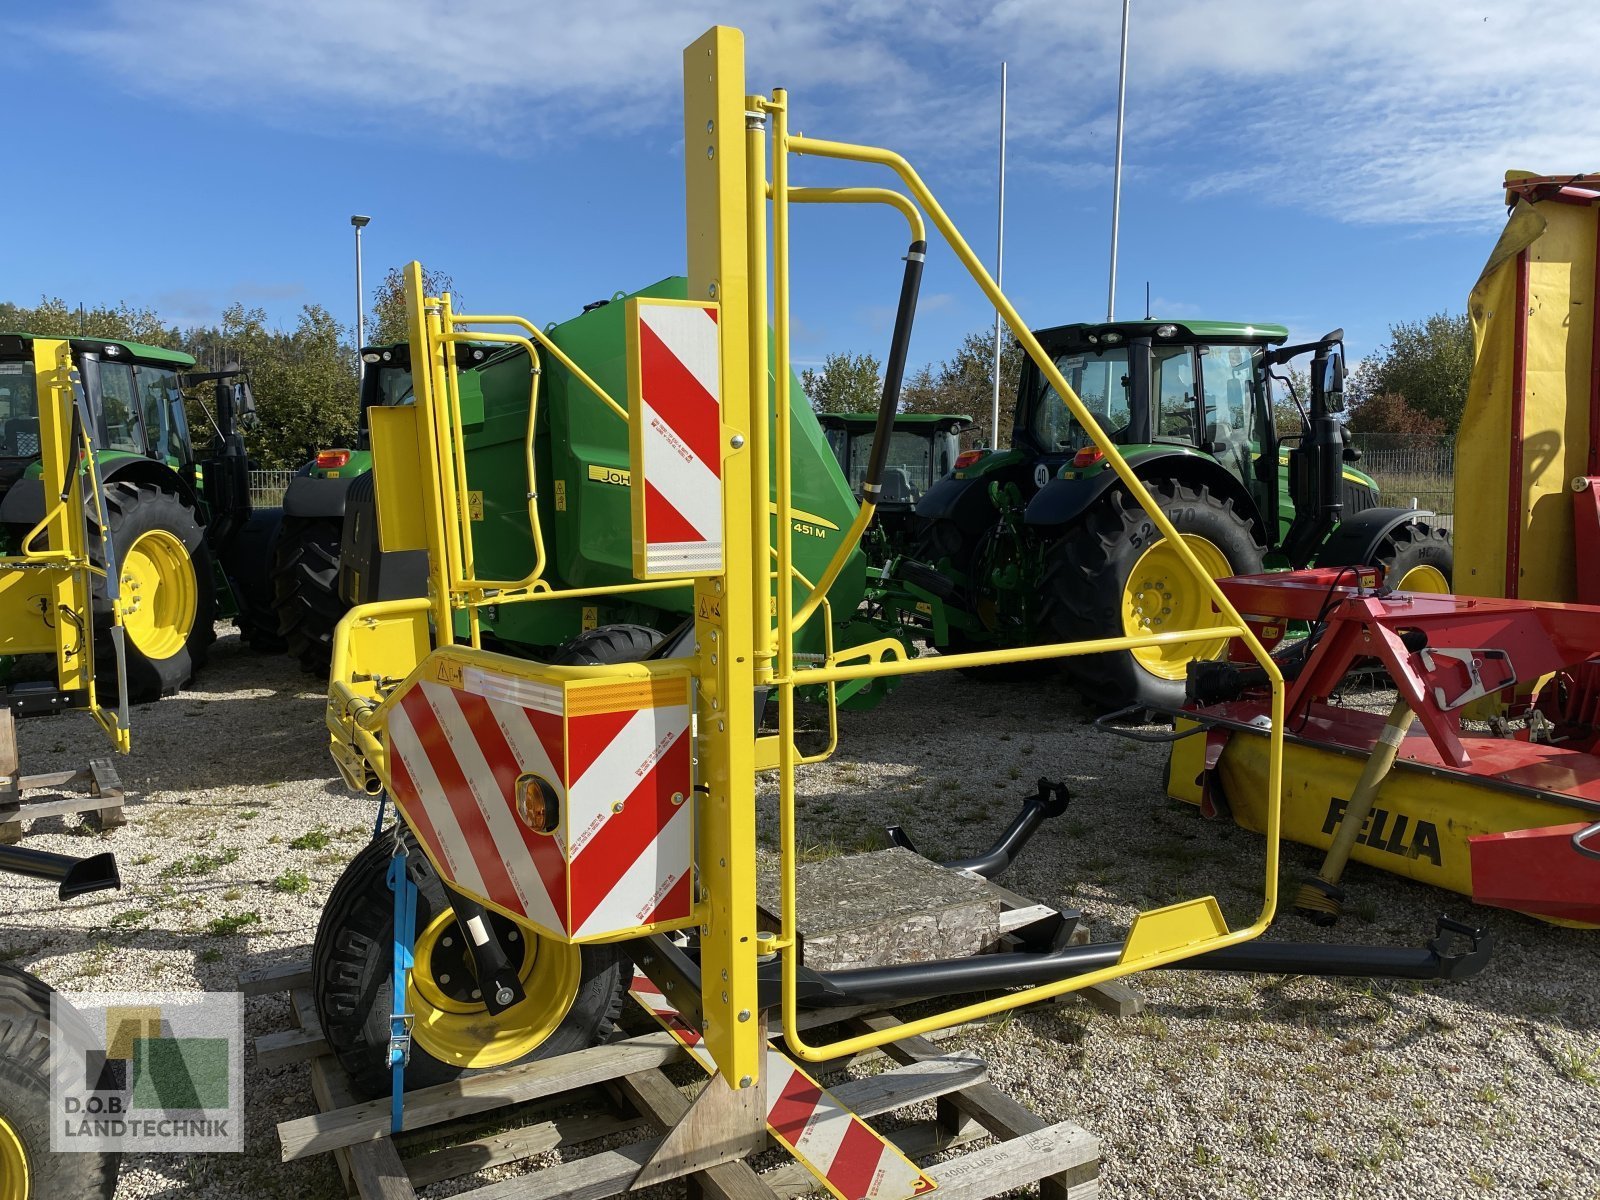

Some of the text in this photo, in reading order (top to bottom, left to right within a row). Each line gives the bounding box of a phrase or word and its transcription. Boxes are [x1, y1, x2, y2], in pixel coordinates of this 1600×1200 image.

[1037, 468, 1046, 485] 40
[793, 523, 826, 539] 451 M
